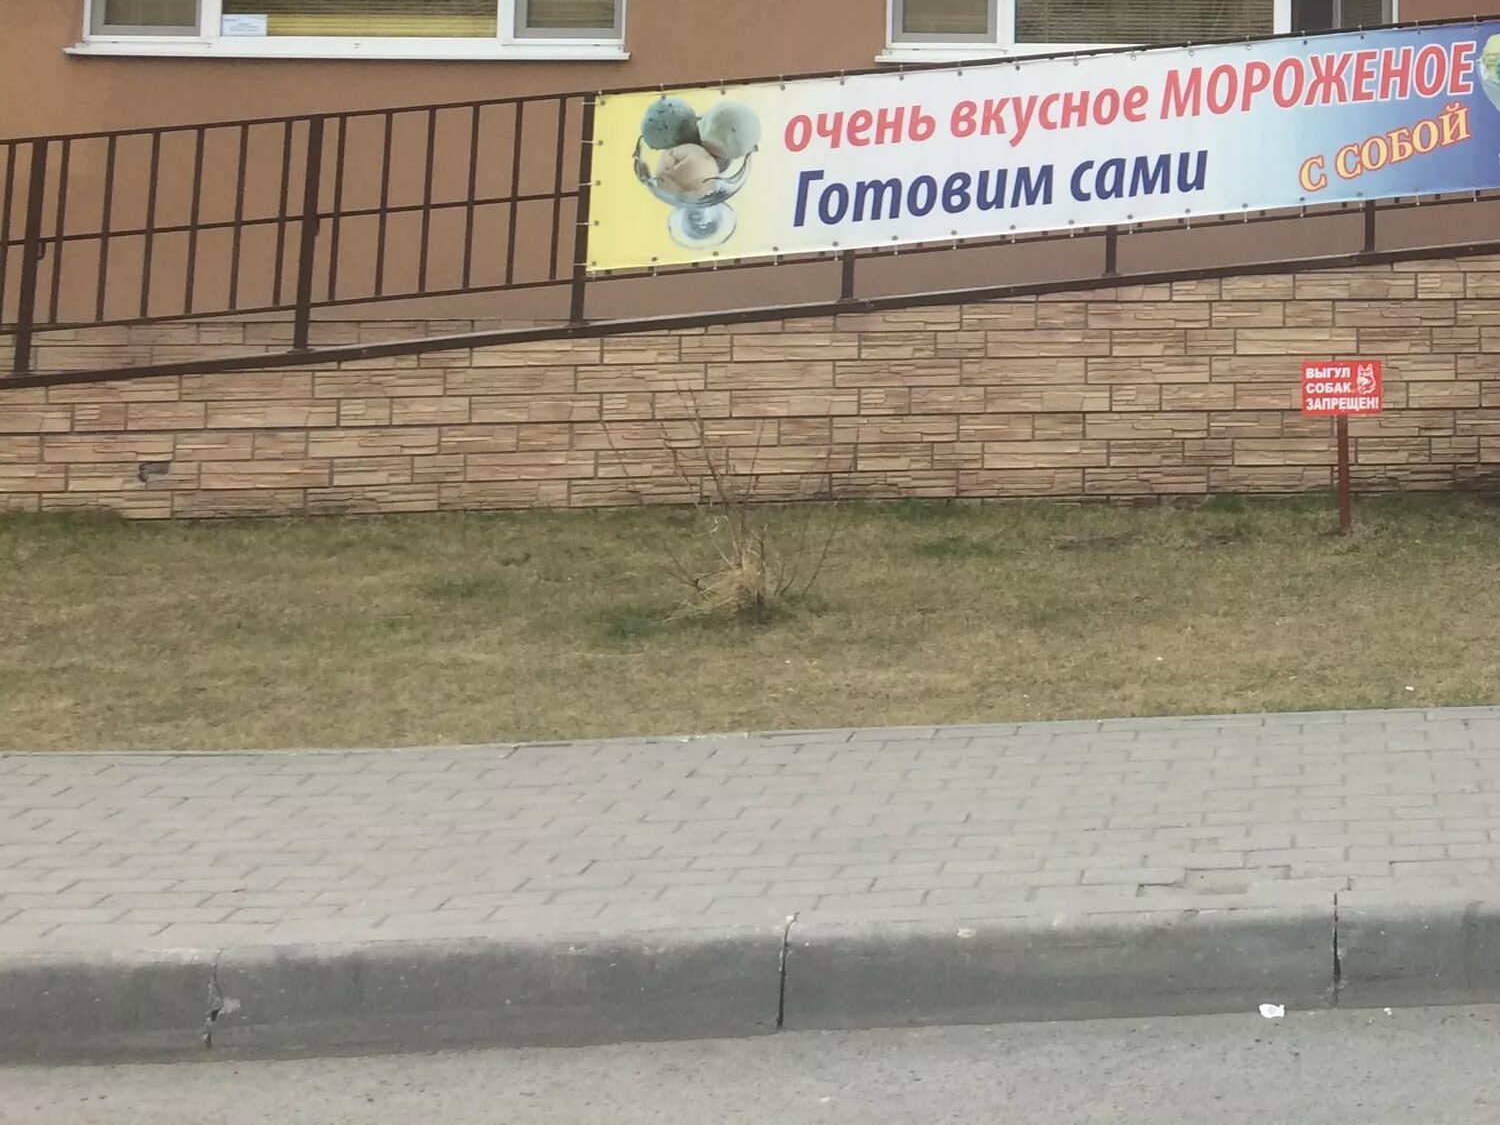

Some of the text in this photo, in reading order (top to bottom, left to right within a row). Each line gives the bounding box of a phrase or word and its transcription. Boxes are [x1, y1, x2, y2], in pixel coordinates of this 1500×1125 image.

[784, 41, 1478, 152] очень вкусное МОРОЖЕНОЕ
[1335, 102, 1472, 179] СОБОЙ
[793, 150, 1208, 227] Готовим сами
[1305, 367, 1351, 379] ВЫГУЛ
[1305, 382, 1352, 394] СОБАК
[1306, 396, 1380, 411] ЗАПРЕЩЕН!
